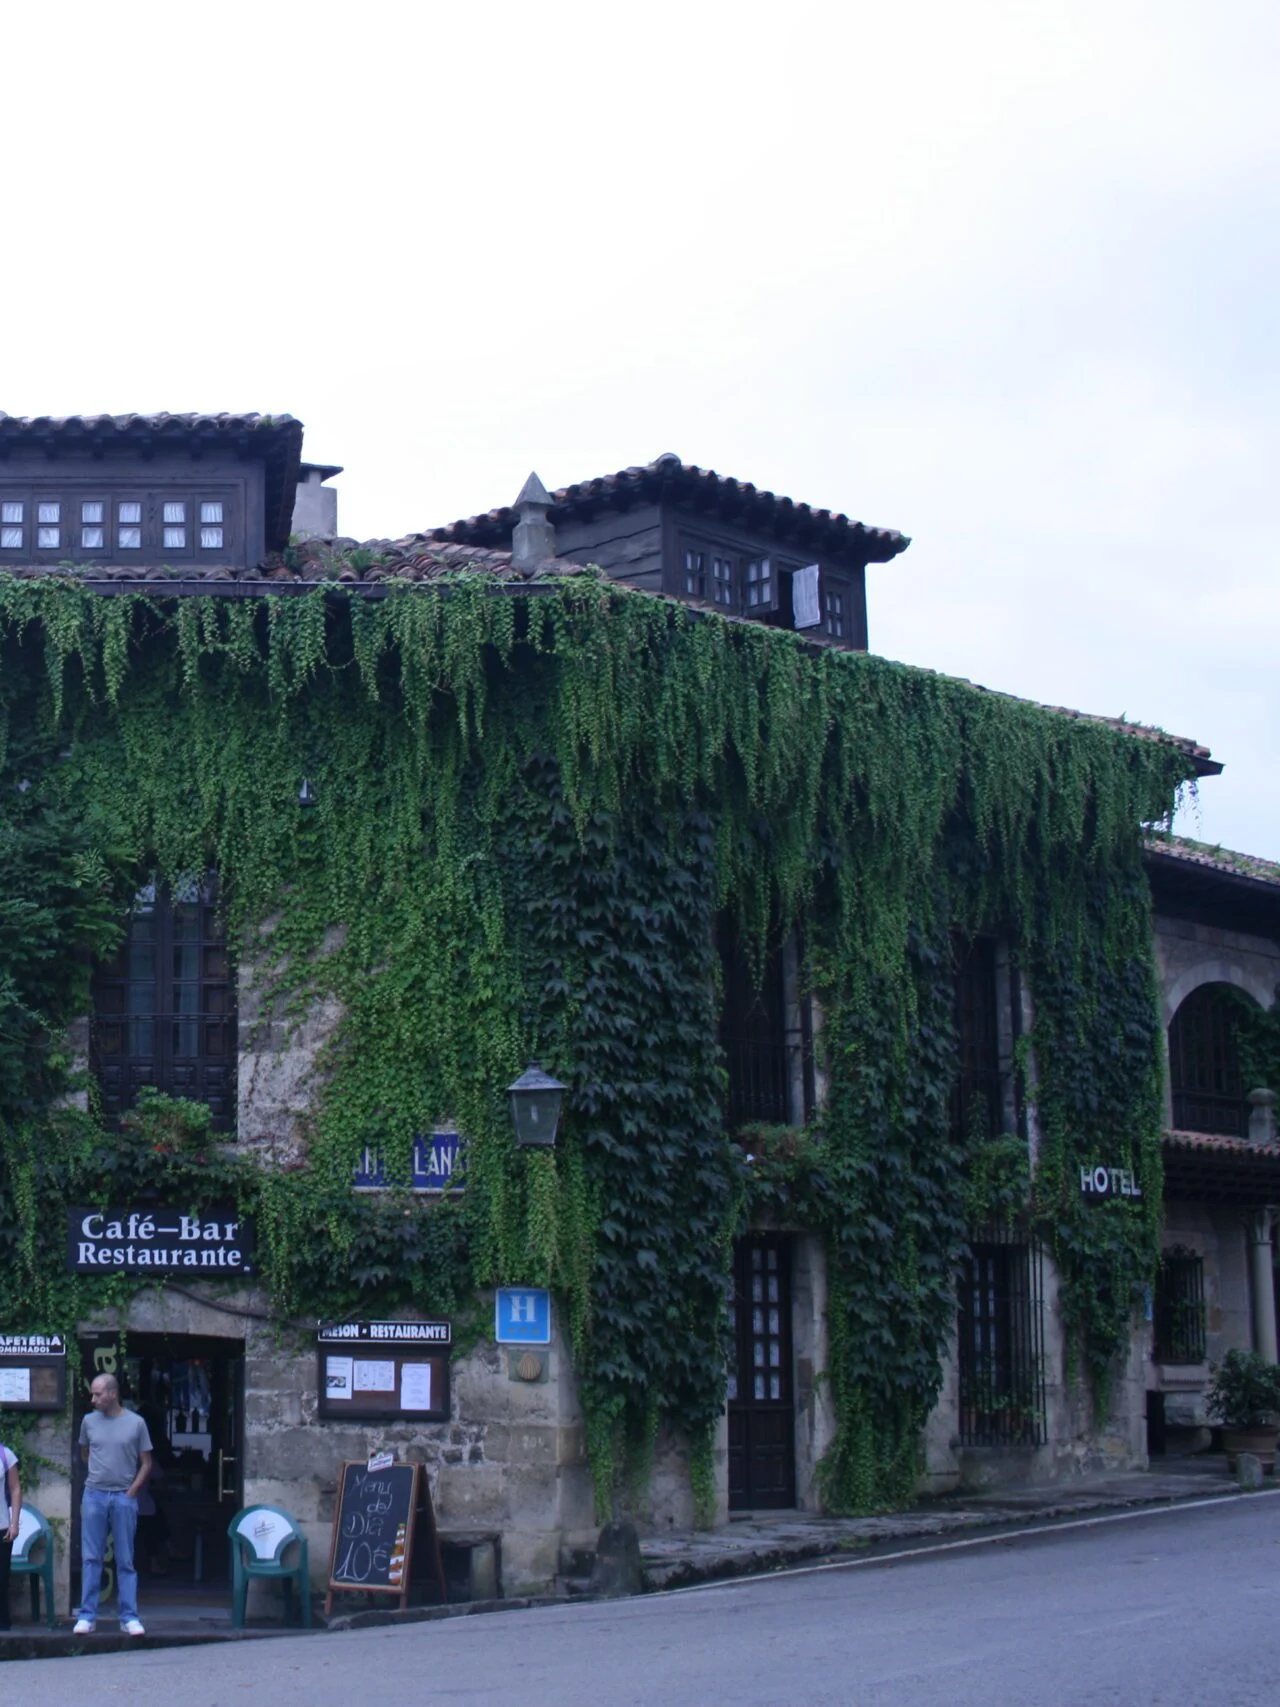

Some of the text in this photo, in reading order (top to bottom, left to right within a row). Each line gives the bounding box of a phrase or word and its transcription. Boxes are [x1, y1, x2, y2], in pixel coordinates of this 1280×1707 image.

[1080, 1166, 1142, 1196] HOTEL
[77, 1242, 242, 1267] Restaurante
[510, 1295, 536, 1323] H
[370, 1324, 447, 1339] RESTAURANTE
[366, 1494, 393, 1515] del
[336, 1541, 388, 1582] 10€
